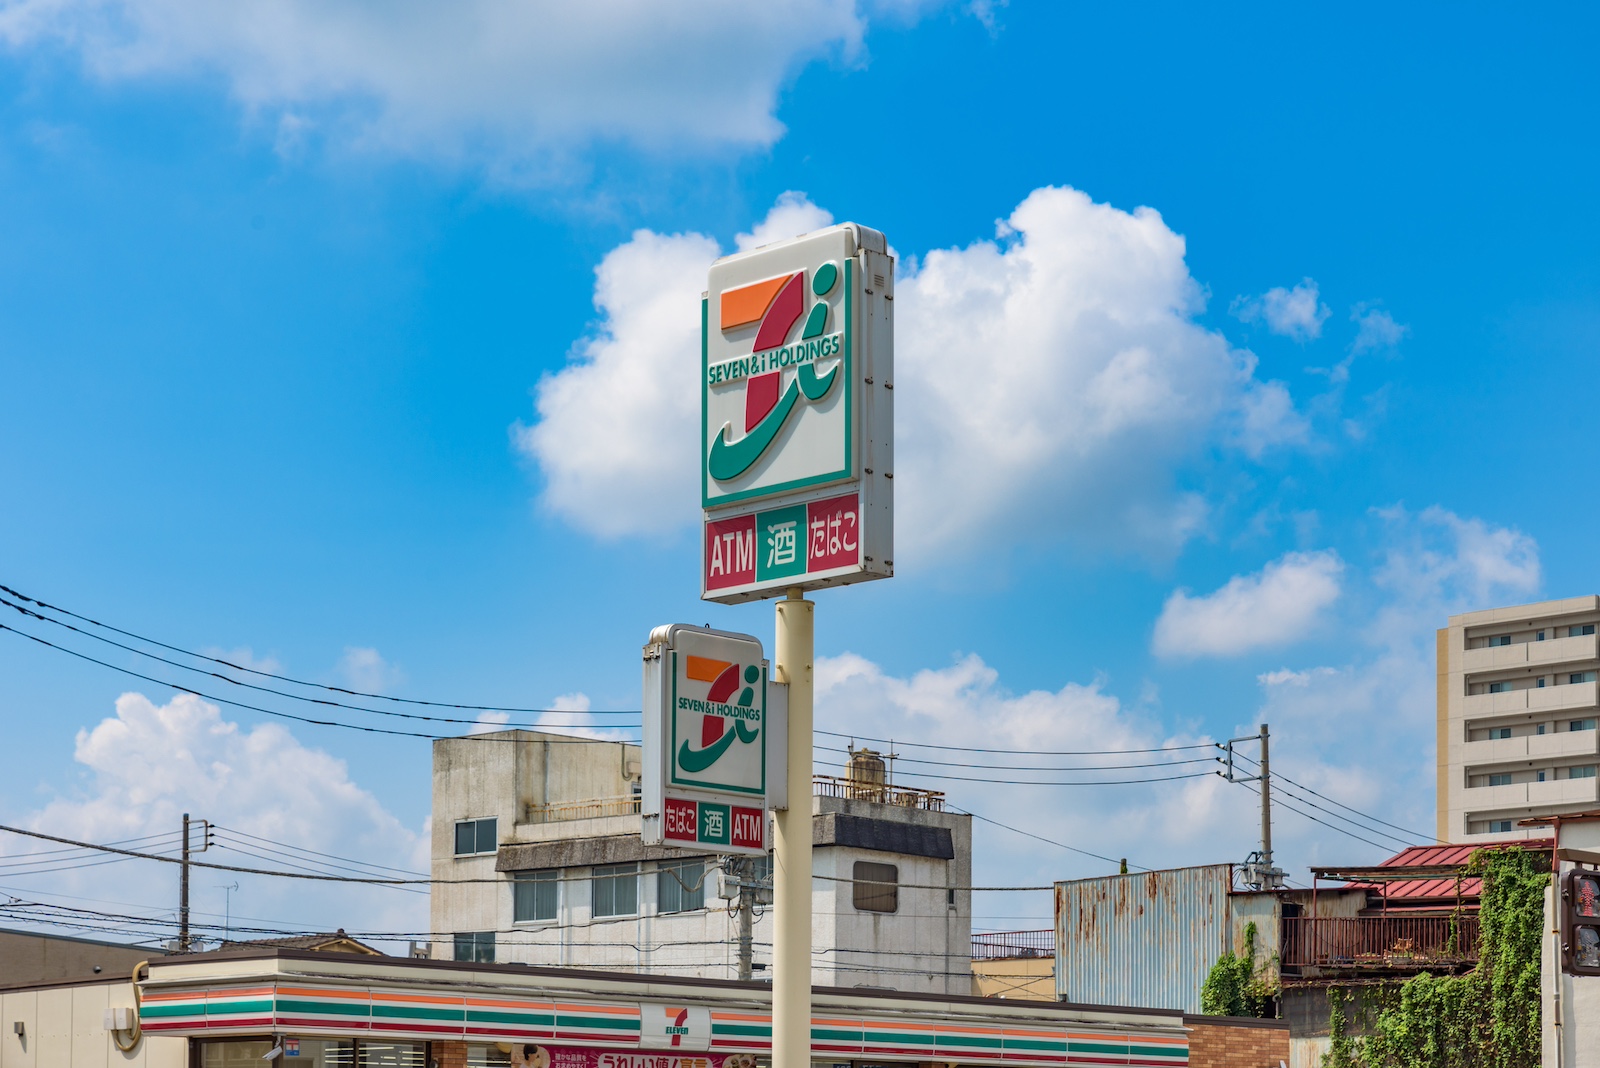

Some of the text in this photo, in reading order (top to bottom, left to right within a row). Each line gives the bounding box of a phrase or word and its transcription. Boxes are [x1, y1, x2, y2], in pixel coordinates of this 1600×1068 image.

[769, 335, 839, 370] HOLDINGS
[766, 520, 797, 568] 酒
[810, 510, 857, 560] たばこ
[709, 528, 753, 577] ATM
[717, 703, 760, 721] HOLDINGS
[665, 805, 695, 834] たばこ
[704, 809, 724, 837] 酒
[733, 813, 761, 842] ATM
